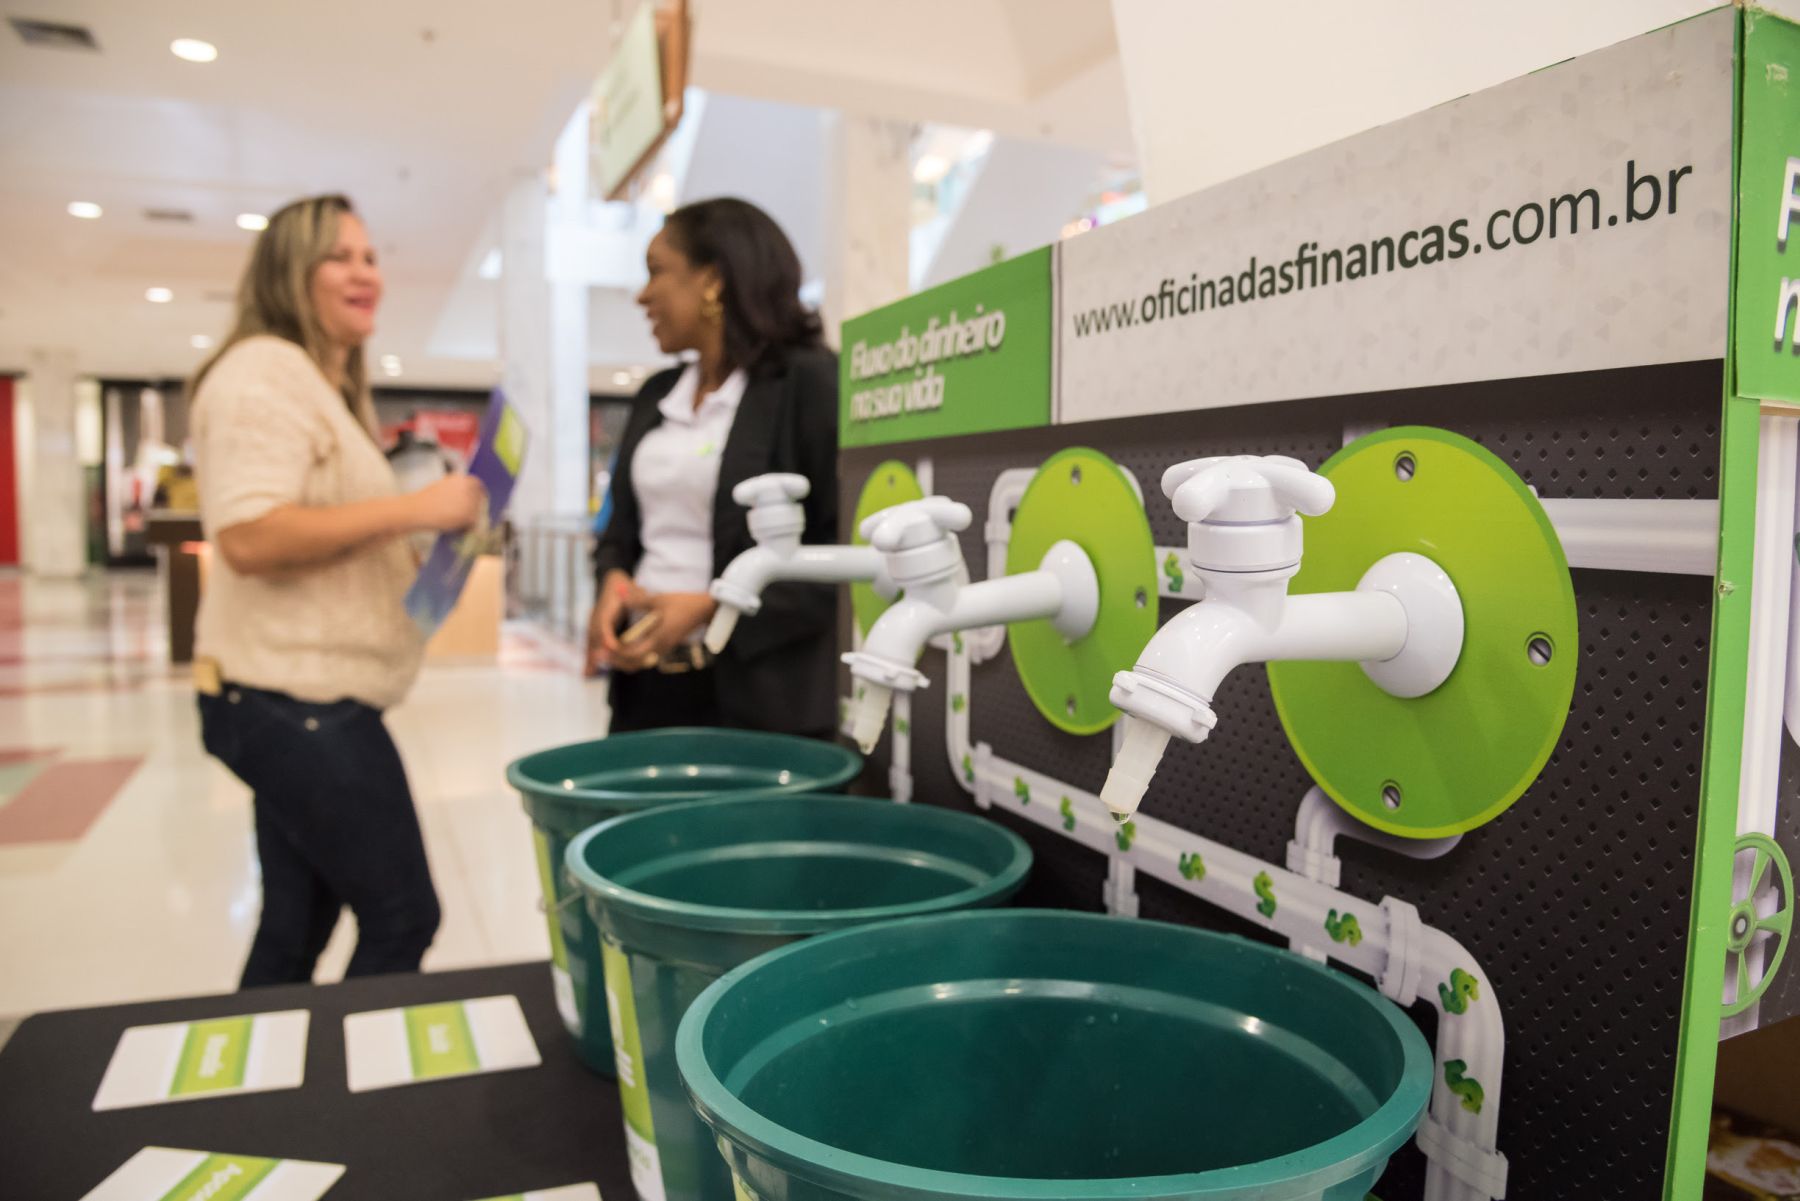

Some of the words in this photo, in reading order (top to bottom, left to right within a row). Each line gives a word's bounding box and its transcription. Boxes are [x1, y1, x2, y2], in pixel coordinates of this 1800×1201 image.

[1073, 160, 1693, 338] www.oficinadasfinancas.com.br
[850, 339, 893, 380] Fluxo
[894, 326, 917, 369] do
[919, 304, 1005, 364] dinheiro
[904, 364, 945, 411] vida
